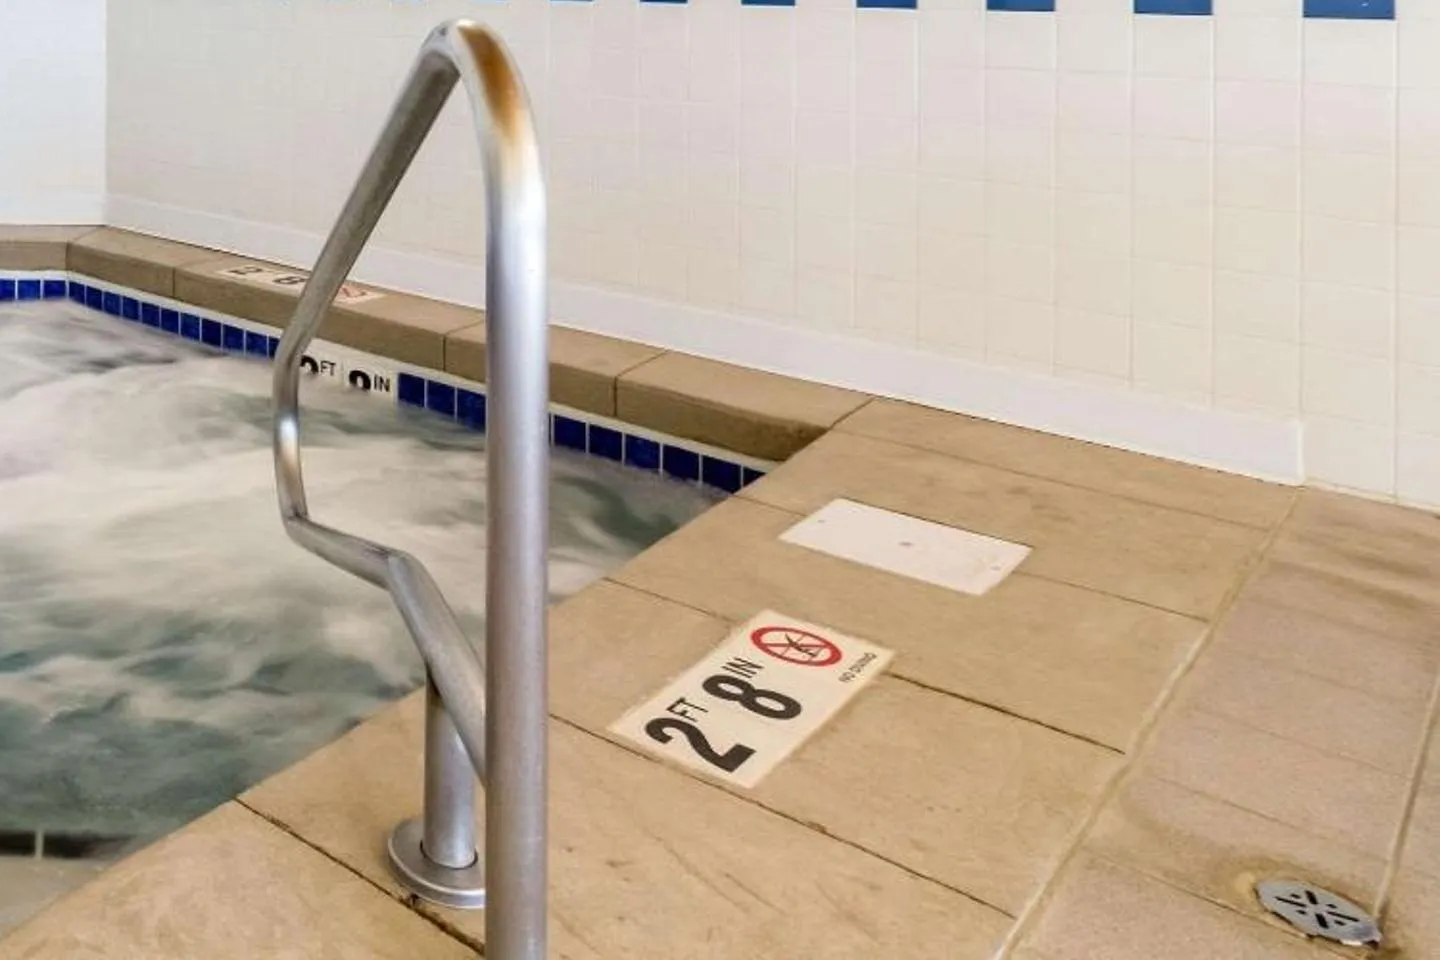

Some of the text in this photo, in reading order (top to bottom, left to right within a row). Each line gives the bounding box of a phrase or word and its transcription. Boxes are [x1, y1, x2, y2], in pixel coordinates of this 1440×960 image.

[320, 360, 336, 376] FT
[374, 374, 391, 393] IN
[645, 657, 802, 773] 2 FT 8 IN
